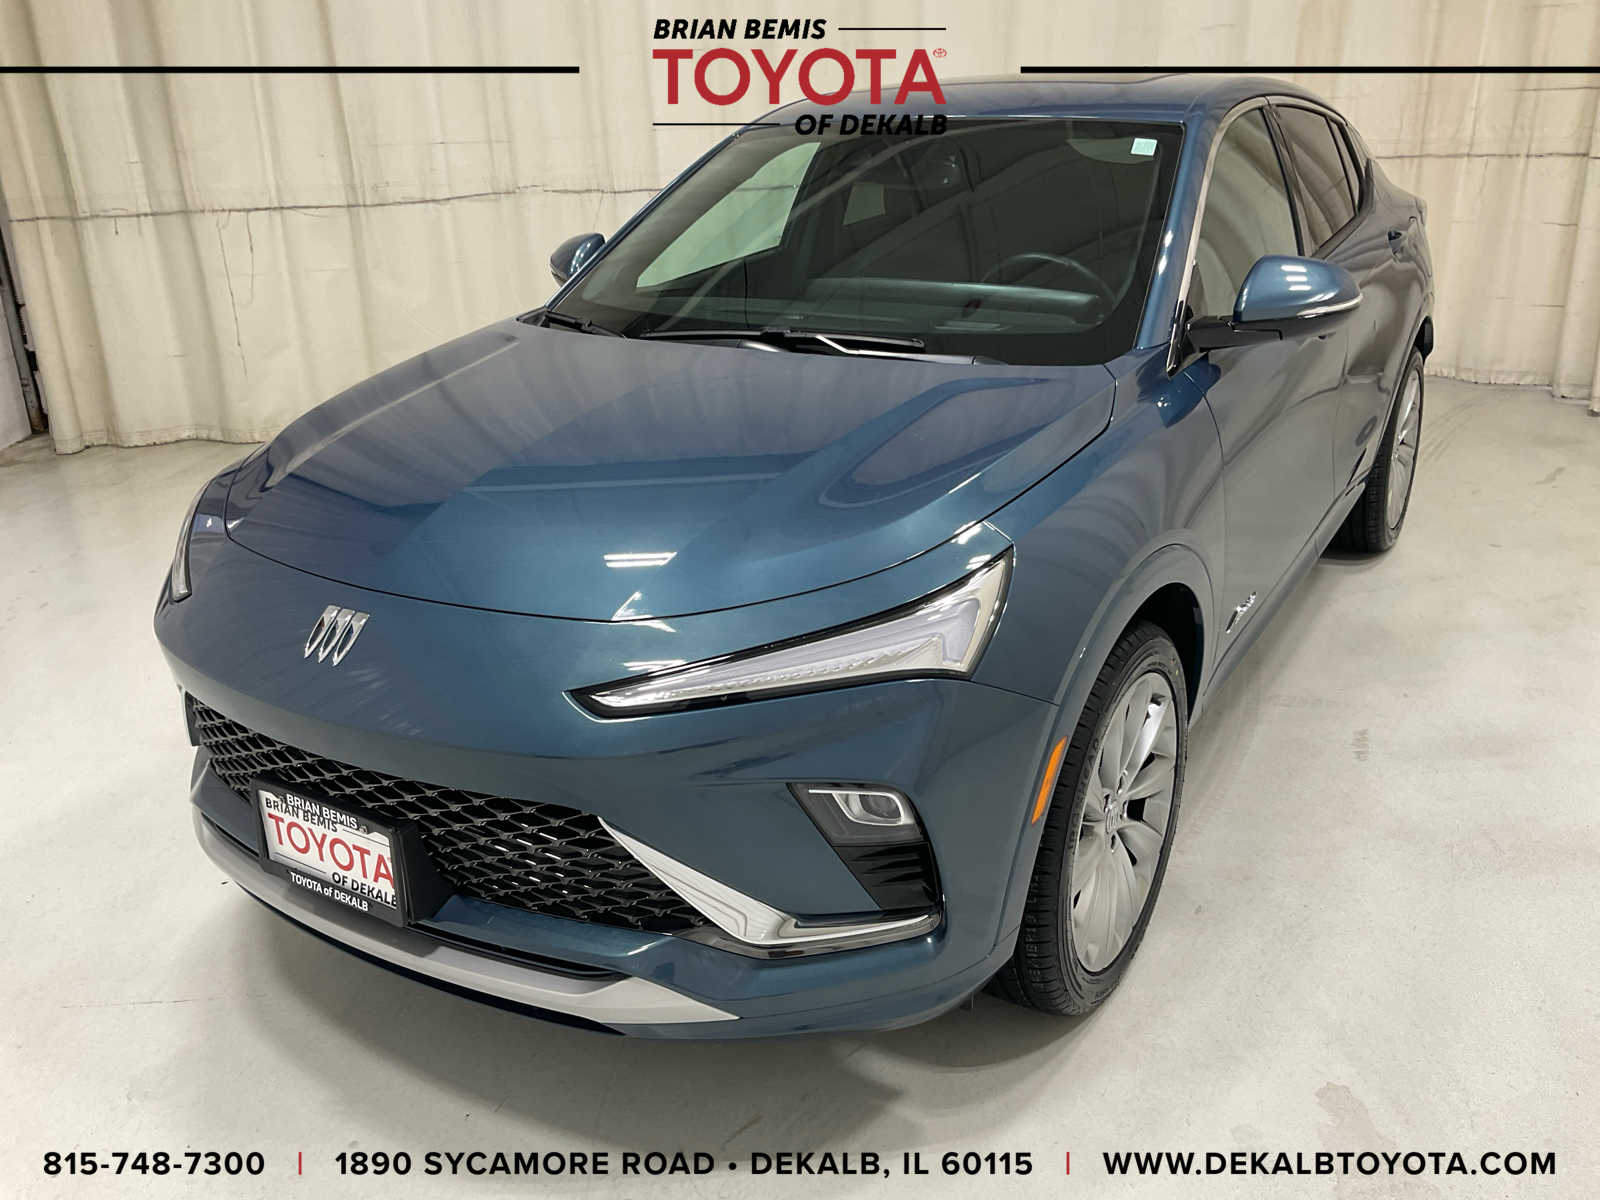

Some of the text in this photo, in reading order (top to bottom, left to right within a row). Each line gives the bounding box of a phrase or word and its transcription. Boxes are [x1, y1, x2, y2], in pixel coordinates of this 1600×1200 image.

[265, 797, 338, 833] BRIAN BEMIS
[286, 793, 358, 829] BRIAN BEMIS
[267, 812, 395, 888] TOYOTA
[290, 871, 369, 912] TOYOTA of DEKALB
[332, 871, 349, 886] OF
